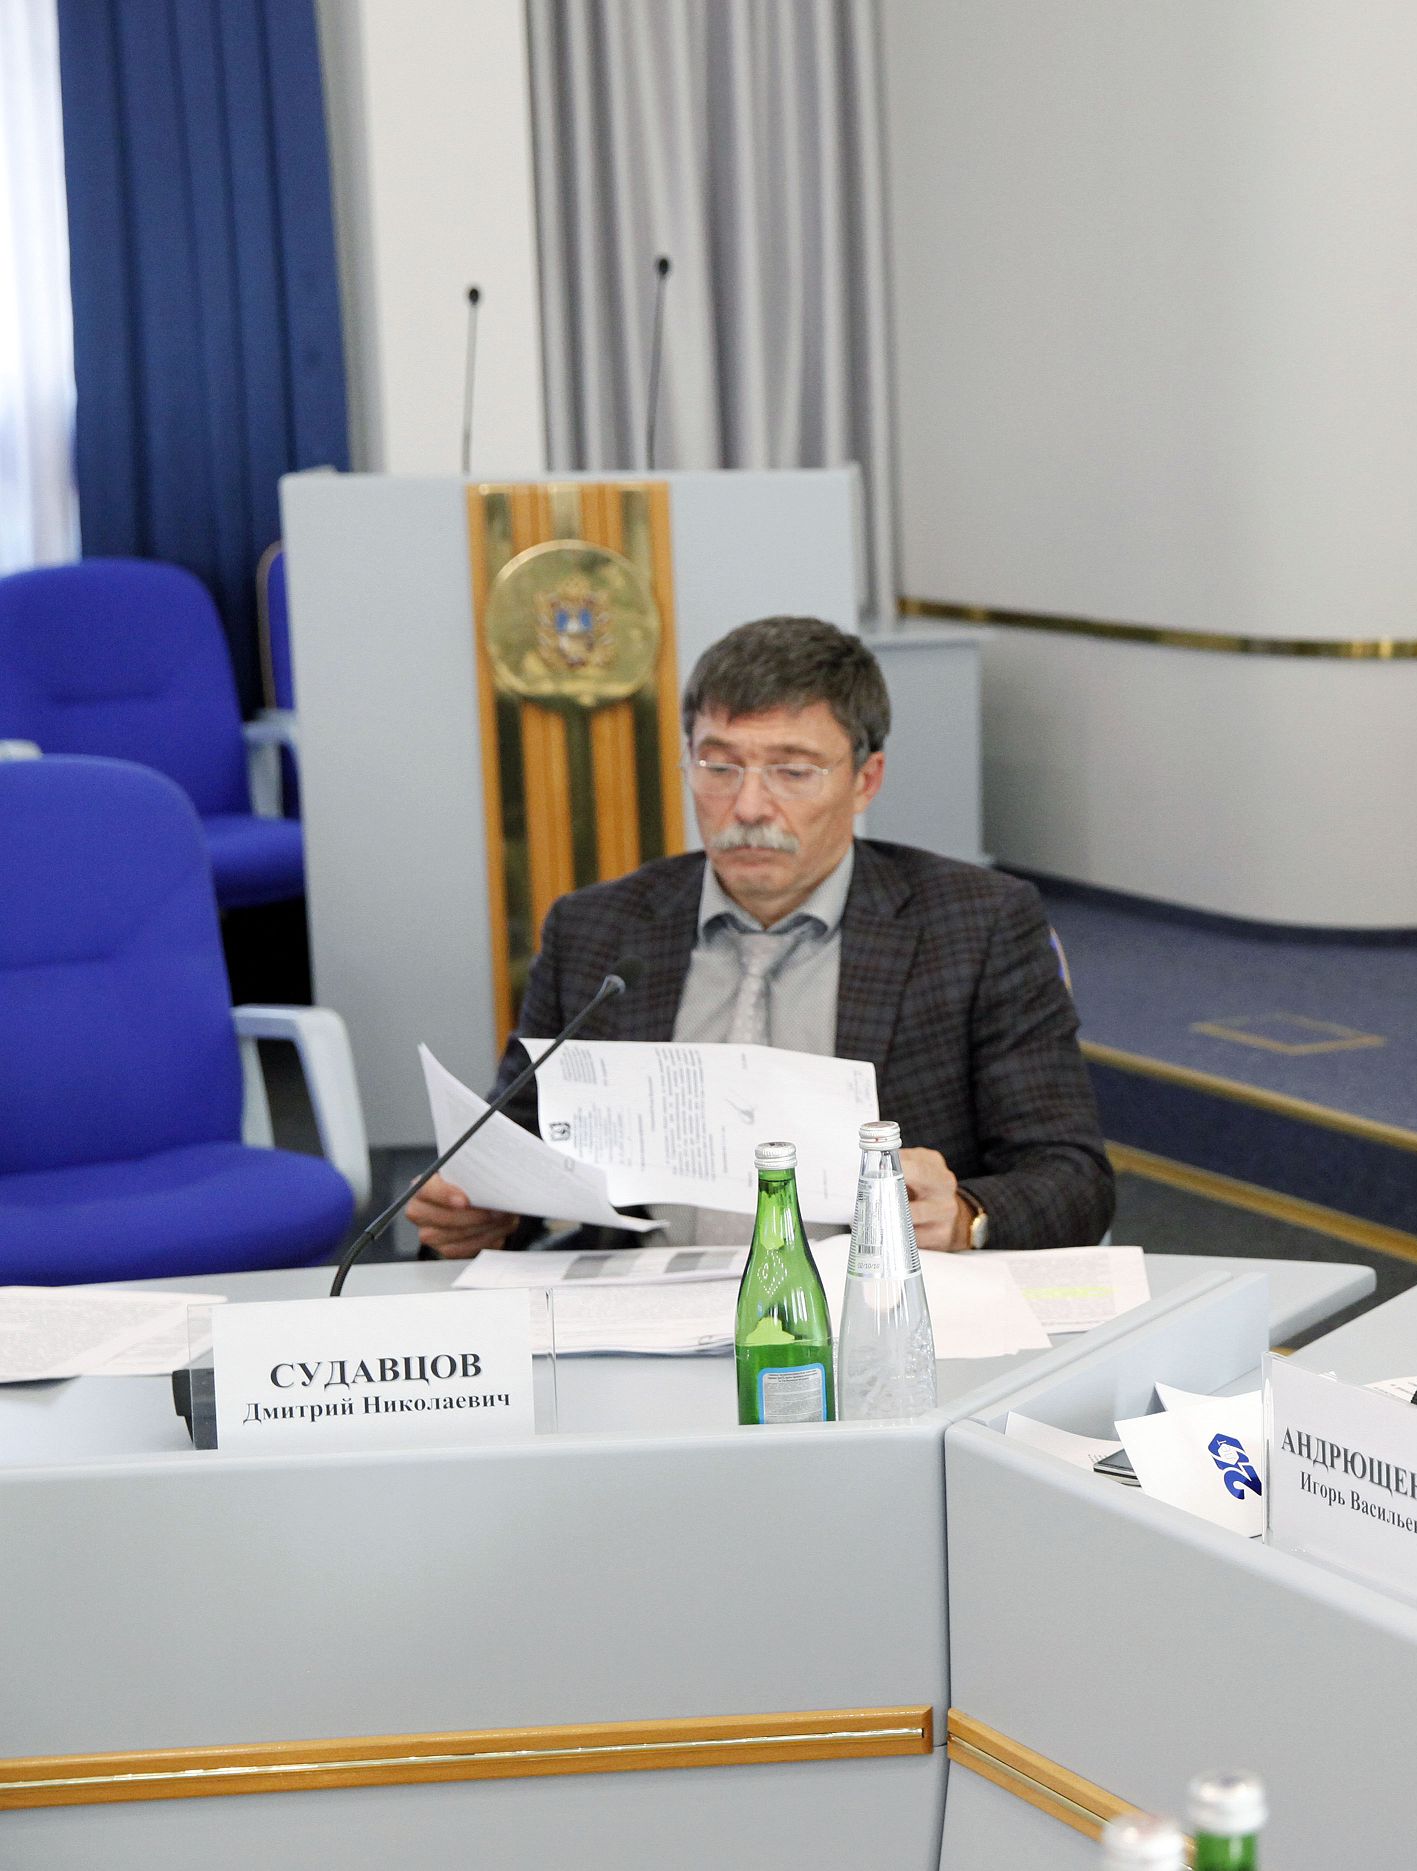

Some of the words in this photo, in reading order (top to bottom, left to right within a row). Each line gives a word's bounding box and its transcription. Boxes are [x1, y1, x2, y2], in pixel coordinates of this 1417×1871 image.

[270, 1353, 482, 1391] СУДАВЦОВ
[242, 1398, 354, 1425] Дмитрий
[362, 1394, 511, 1415] Николаевич
[1300, 1471, 1346, 1507] Игорь
